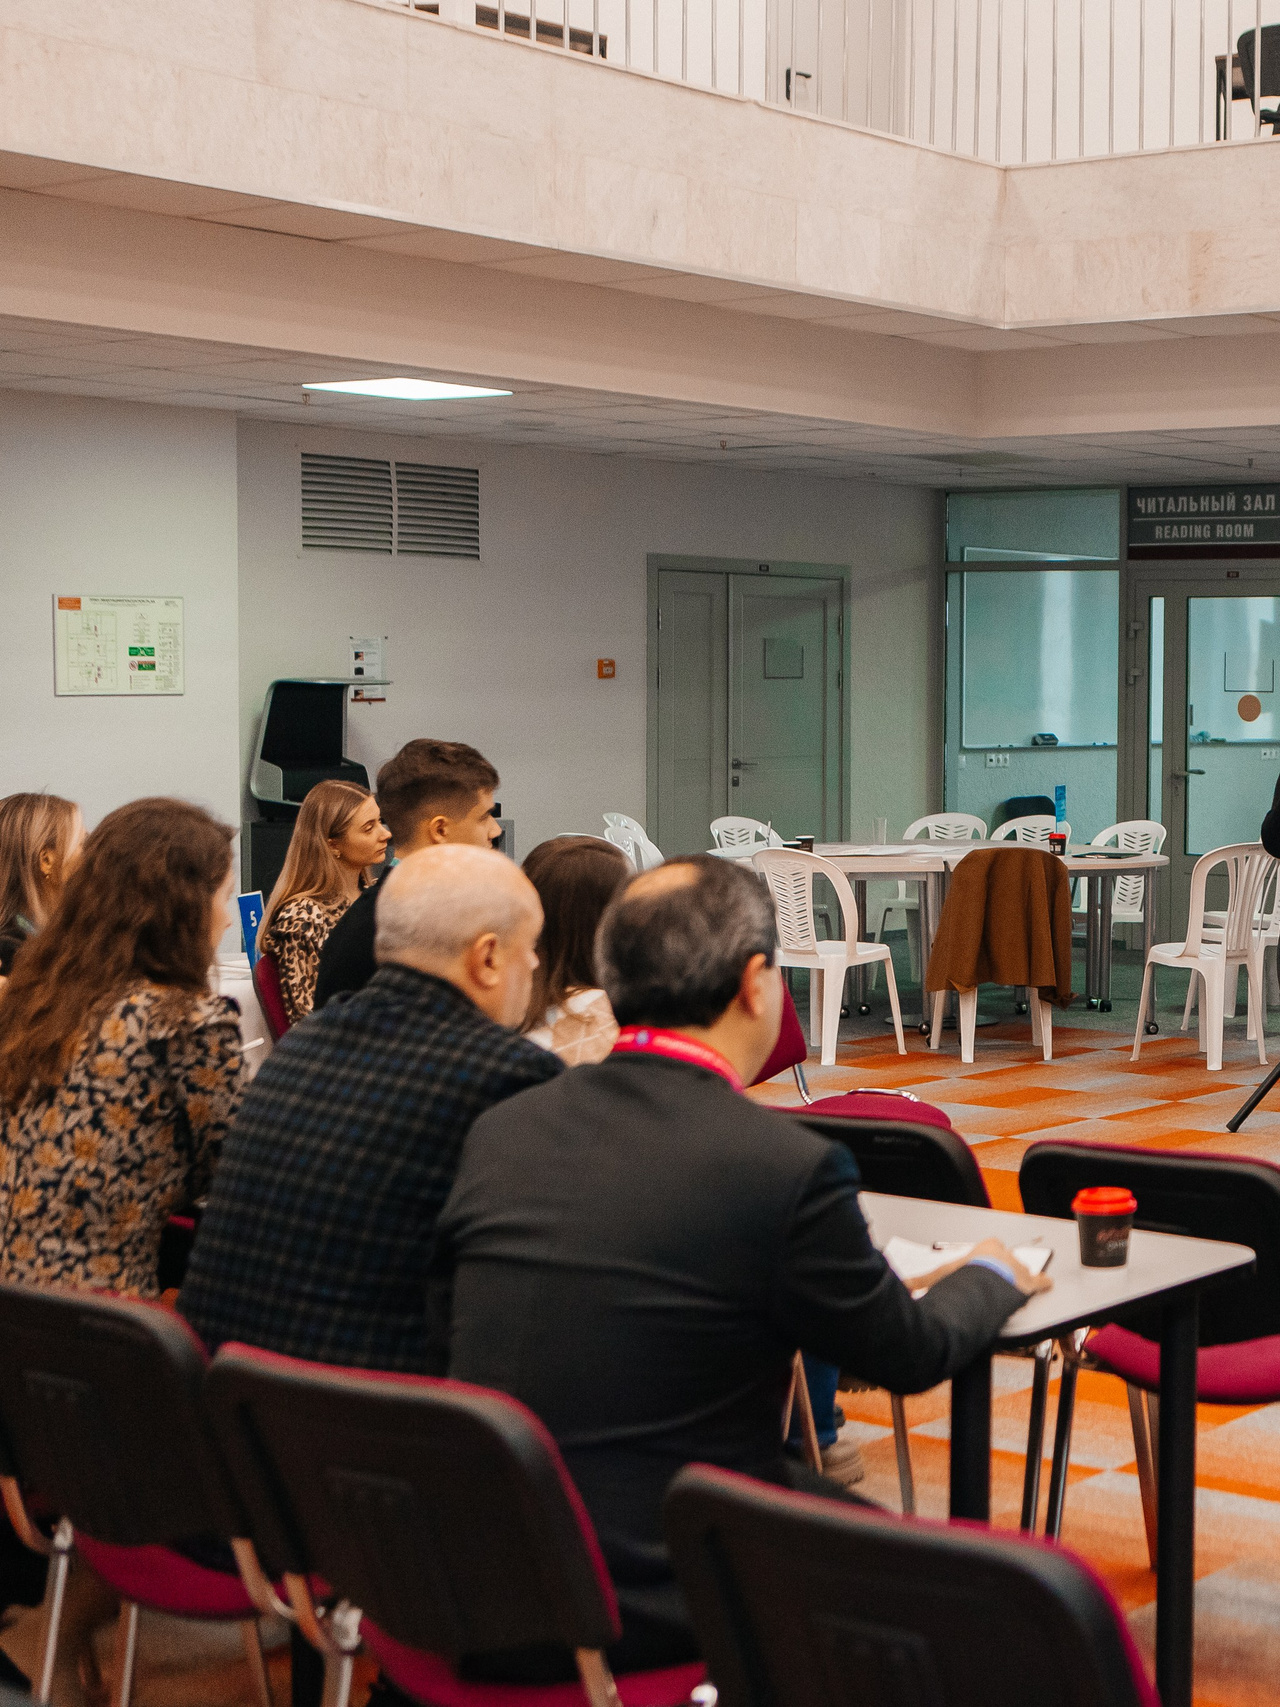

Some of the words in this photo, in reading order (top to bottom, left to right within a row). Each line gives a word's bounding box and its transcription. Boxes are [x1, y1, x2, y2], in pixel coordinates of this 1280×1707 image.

[1136, 492, 1236, 513] ЧИТАЛЬНЫЙ
[1243, 494, 1275, 511] ЗАЛ
[1155, 524, 1210, 539] READING
[1216, 524, 1254, 538] ROOM
